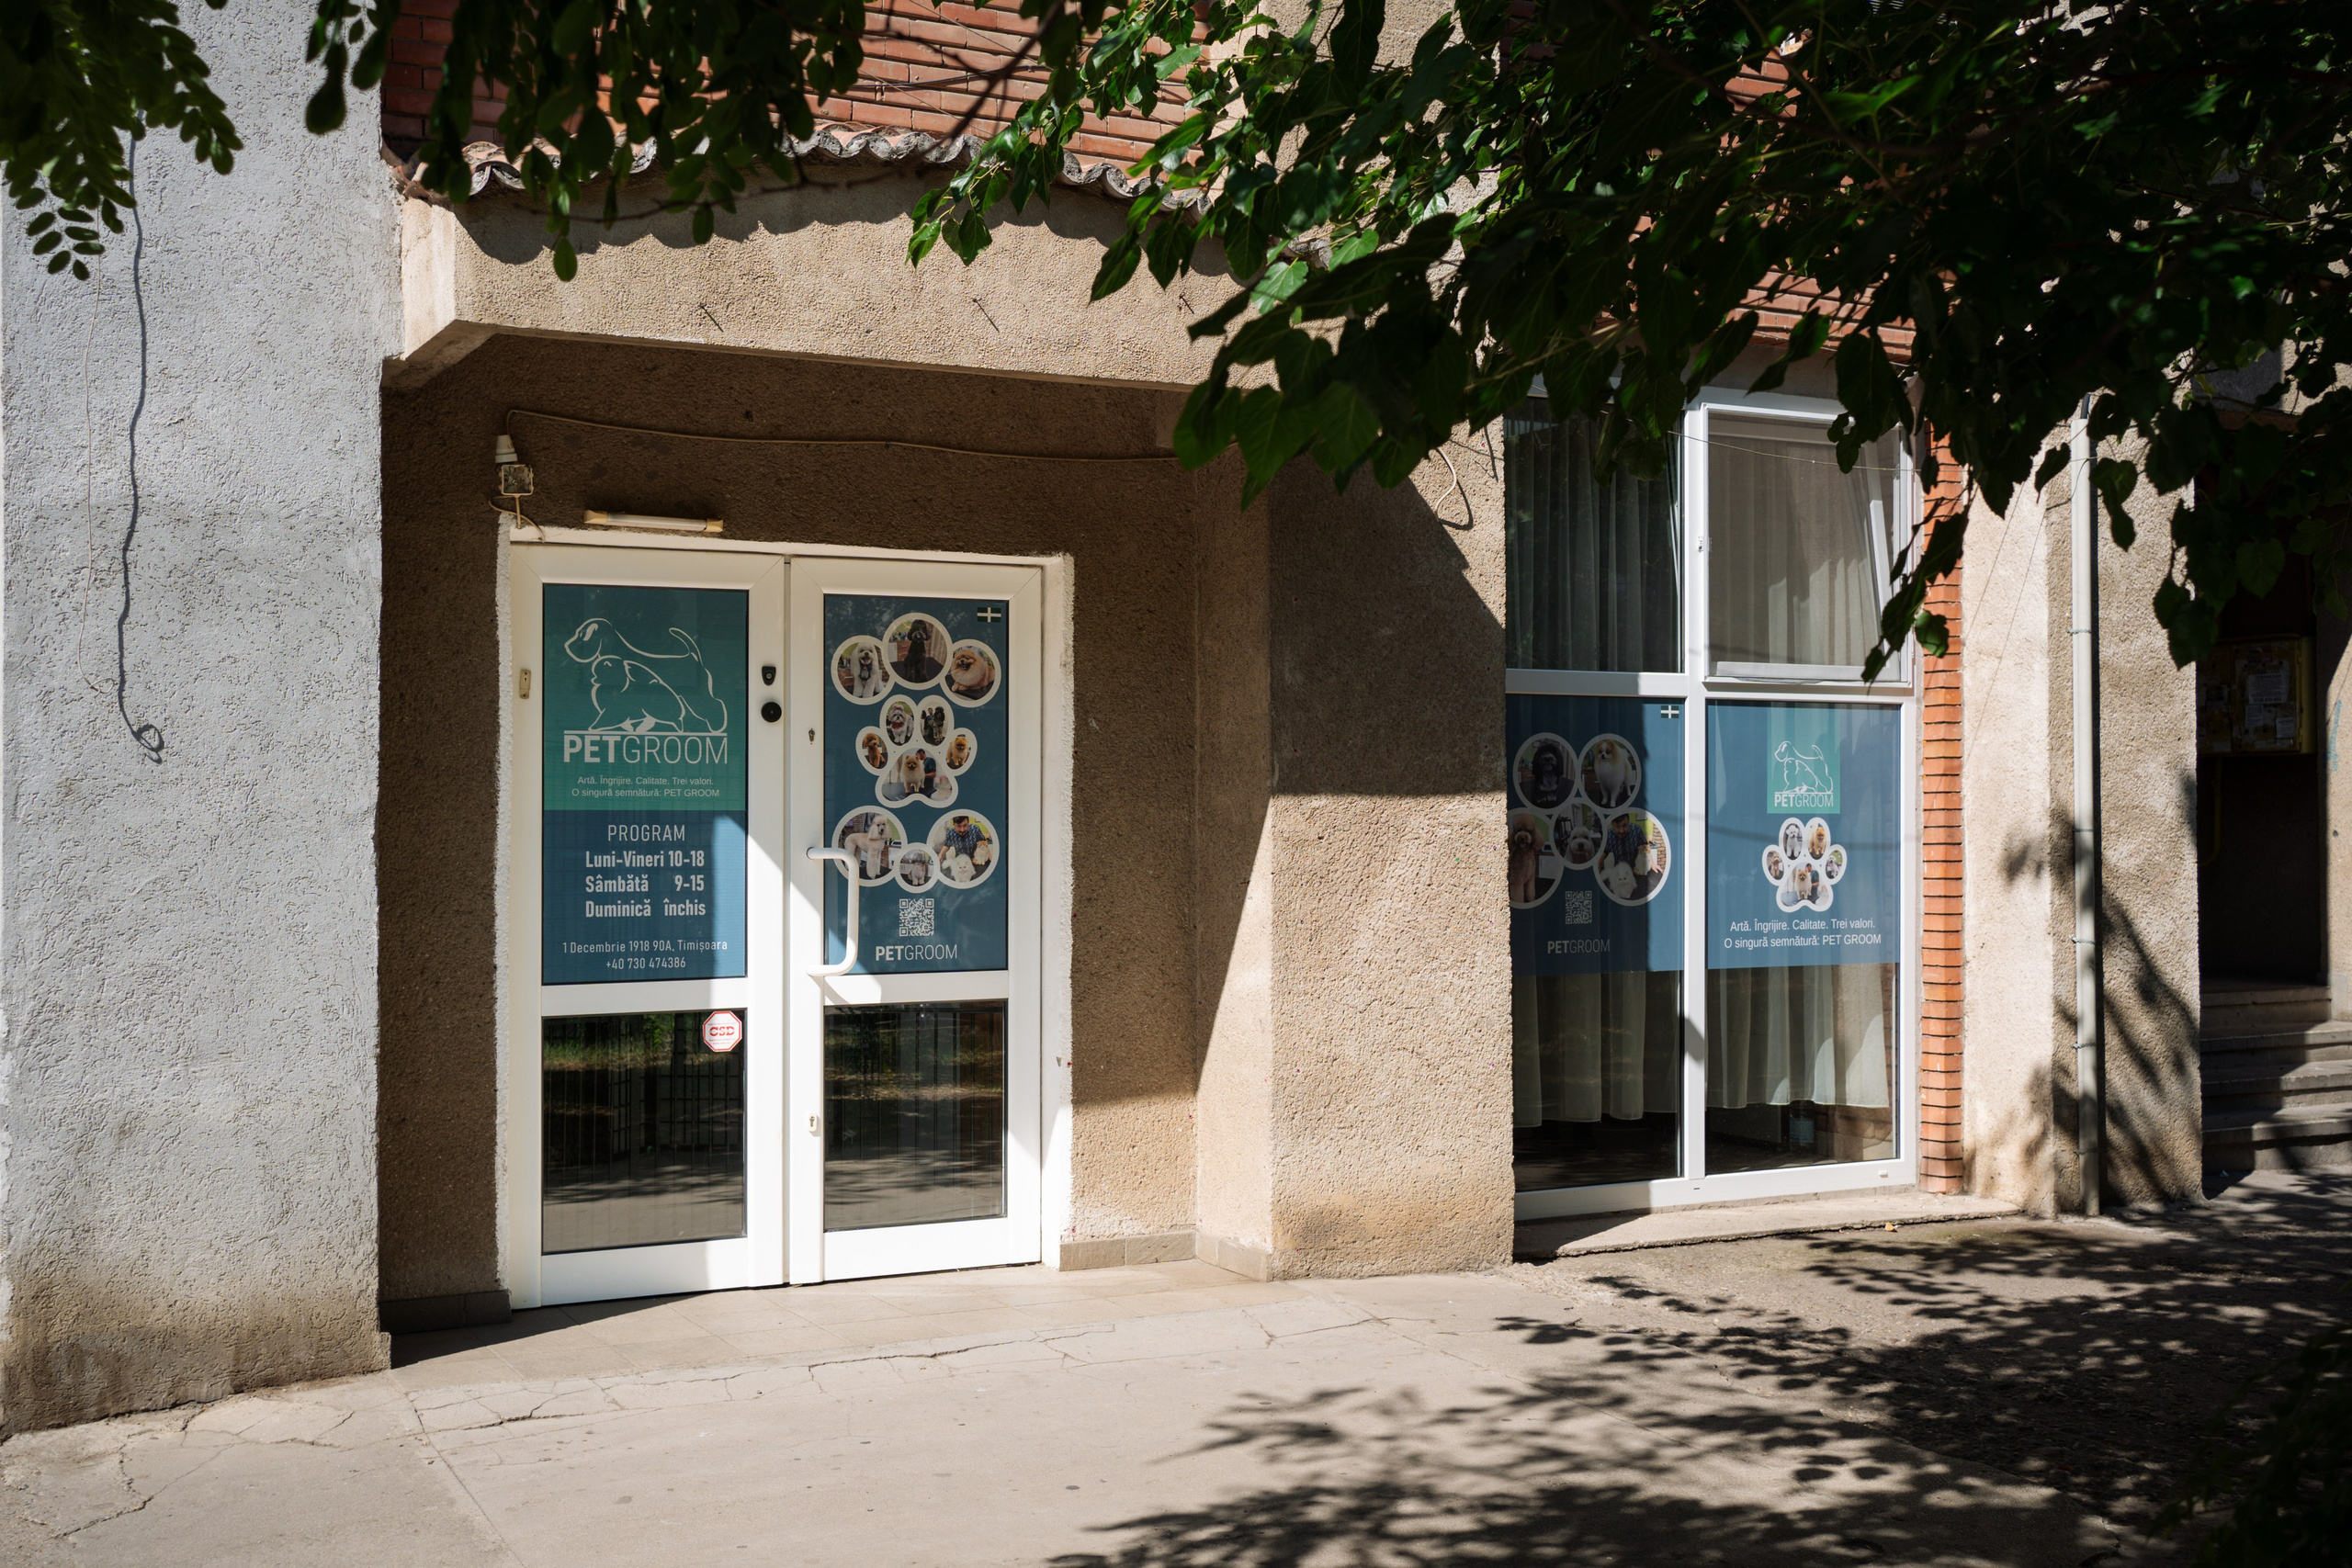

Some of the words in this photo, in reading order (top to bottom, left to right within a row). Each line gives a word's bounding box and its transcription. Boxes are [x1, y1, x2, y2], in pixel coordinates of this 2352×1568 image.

[563, 735, 728, 764] PETGROOM
[577, 776, 597, 785] Artă.
[599, 774, 633, 786] Îngrijire.
[636, 776, 670, 785] Calitate.
[672, 776, 688, 785] Trei
[689, 776, 714, 785] valori.
[571, 788, 580, 796] O
[582, 787, 613, 798] singură
[615, 787, 662, 796] semnătură:
[684, 788, 719, 796] GROOM
[1774, 794, 1834, 807] PETGROOM
[607, 825, 685, 841] PROGRAM
[585, 851, 664, 868] Luni-Vineri
[668, 850, 705, 867] 10-18
[585, 874, 649, 893] Sâmbătă
[674, 874, 705, 892] 9-15
[585, 898, 651, 918] Duminică
[663, 897, 707, 916] închis
[1729, 920, 1752, 931] Artă.
[1754, 919, 1790, 933] Îngrijire.
[1792, 919, 1828, 931] Calitate.
[1830, 919, 1848, 930] Trei
[1849, 918, 1875, 929] valori.
[562, 942, 567, 953] 1
[571, 941, 626, 953] Decembrie
[628, 940, 650, 952] 1918
[652, 940, 674, 952] 90A,
[677, 939, 728, 953] Timișoara
[1547, 939, 1611, 954] PETGROOM
[1724, 938, 1733, 949] O
[1735, 936, 1769, 951] singură
[1770, 935, 1820, 947] semnătură:
[1822, 934, 1841, 946] PET
[1843, 933, 1882, 945] GROOM
[876, 944, 957, 962] PETGROOM
[605, 958, 625, 969] +40
[628, 957, 646, 969] 730
[649, 957, 686, 968] 474386
[709, 1025, 735, 1036] CSD
